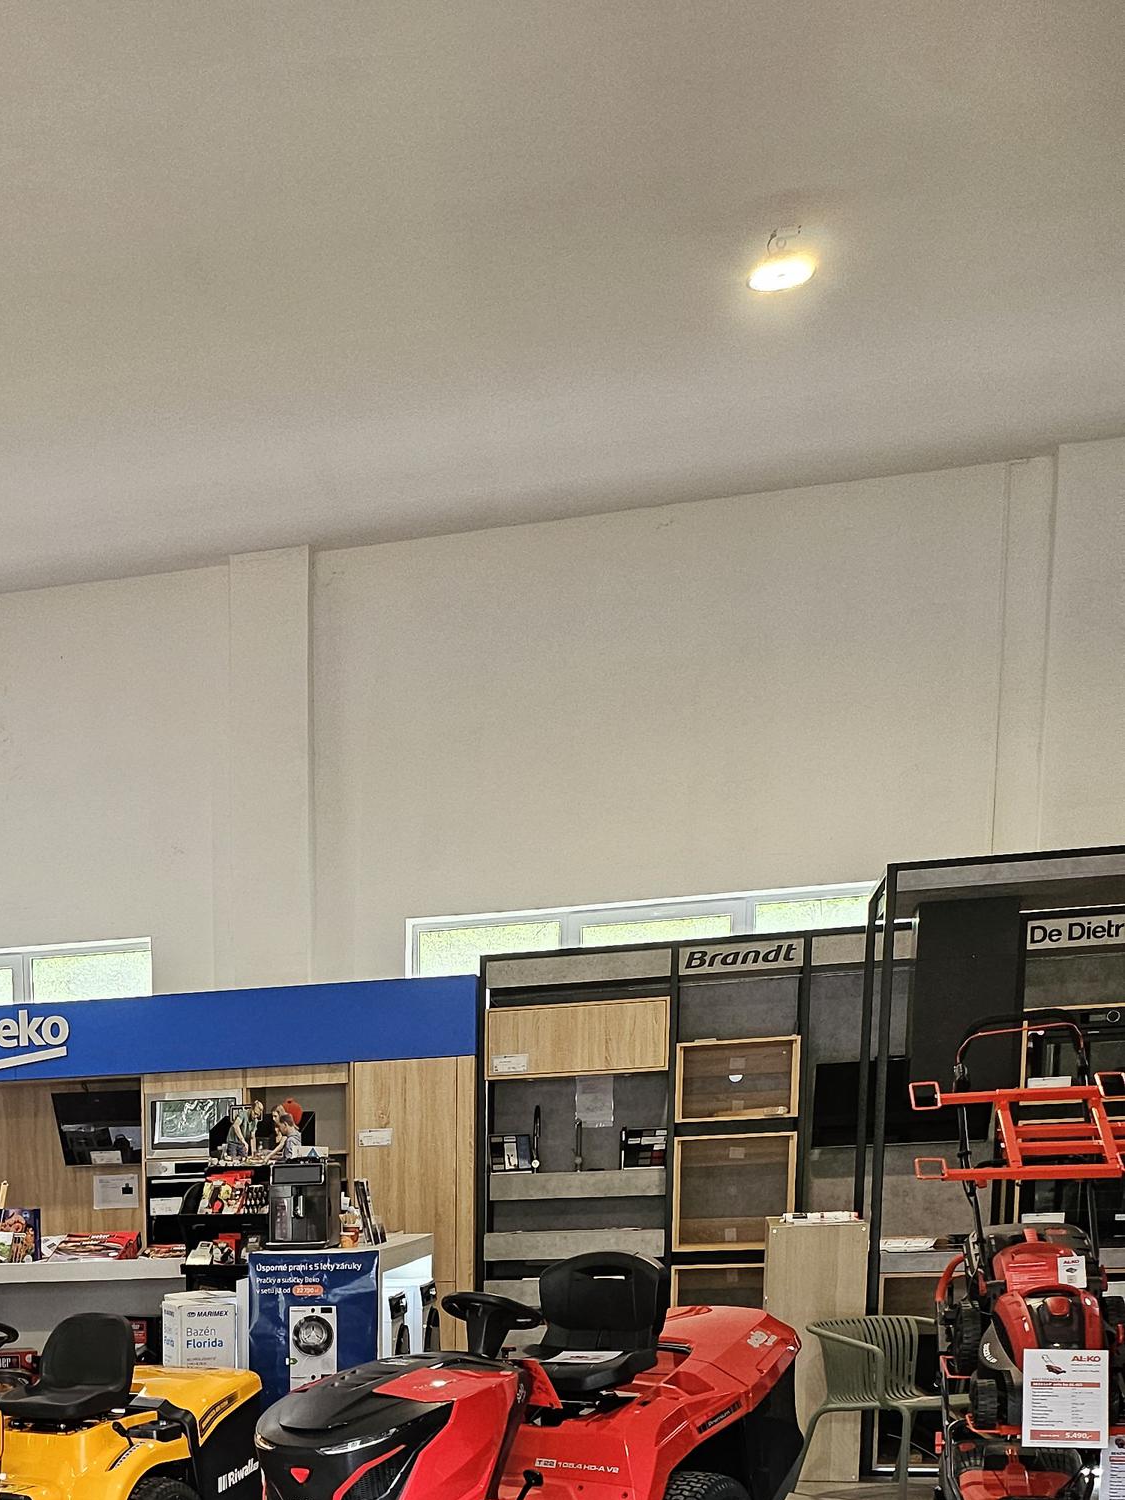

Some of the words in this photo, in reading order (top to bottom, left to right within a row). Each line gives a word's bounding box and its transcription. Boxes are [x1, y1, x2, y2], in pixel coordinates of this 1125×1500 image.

[1030, 925, 1062, 944] De
[684, 943, 797, 969] Brandt
[256, 1263, 287, 1273] Úsporné
[336, 1262, 362, 1272] záruky
[186, 1326, 216, 1337] Bazén
[186, 1338, 224, 1349] Florida
